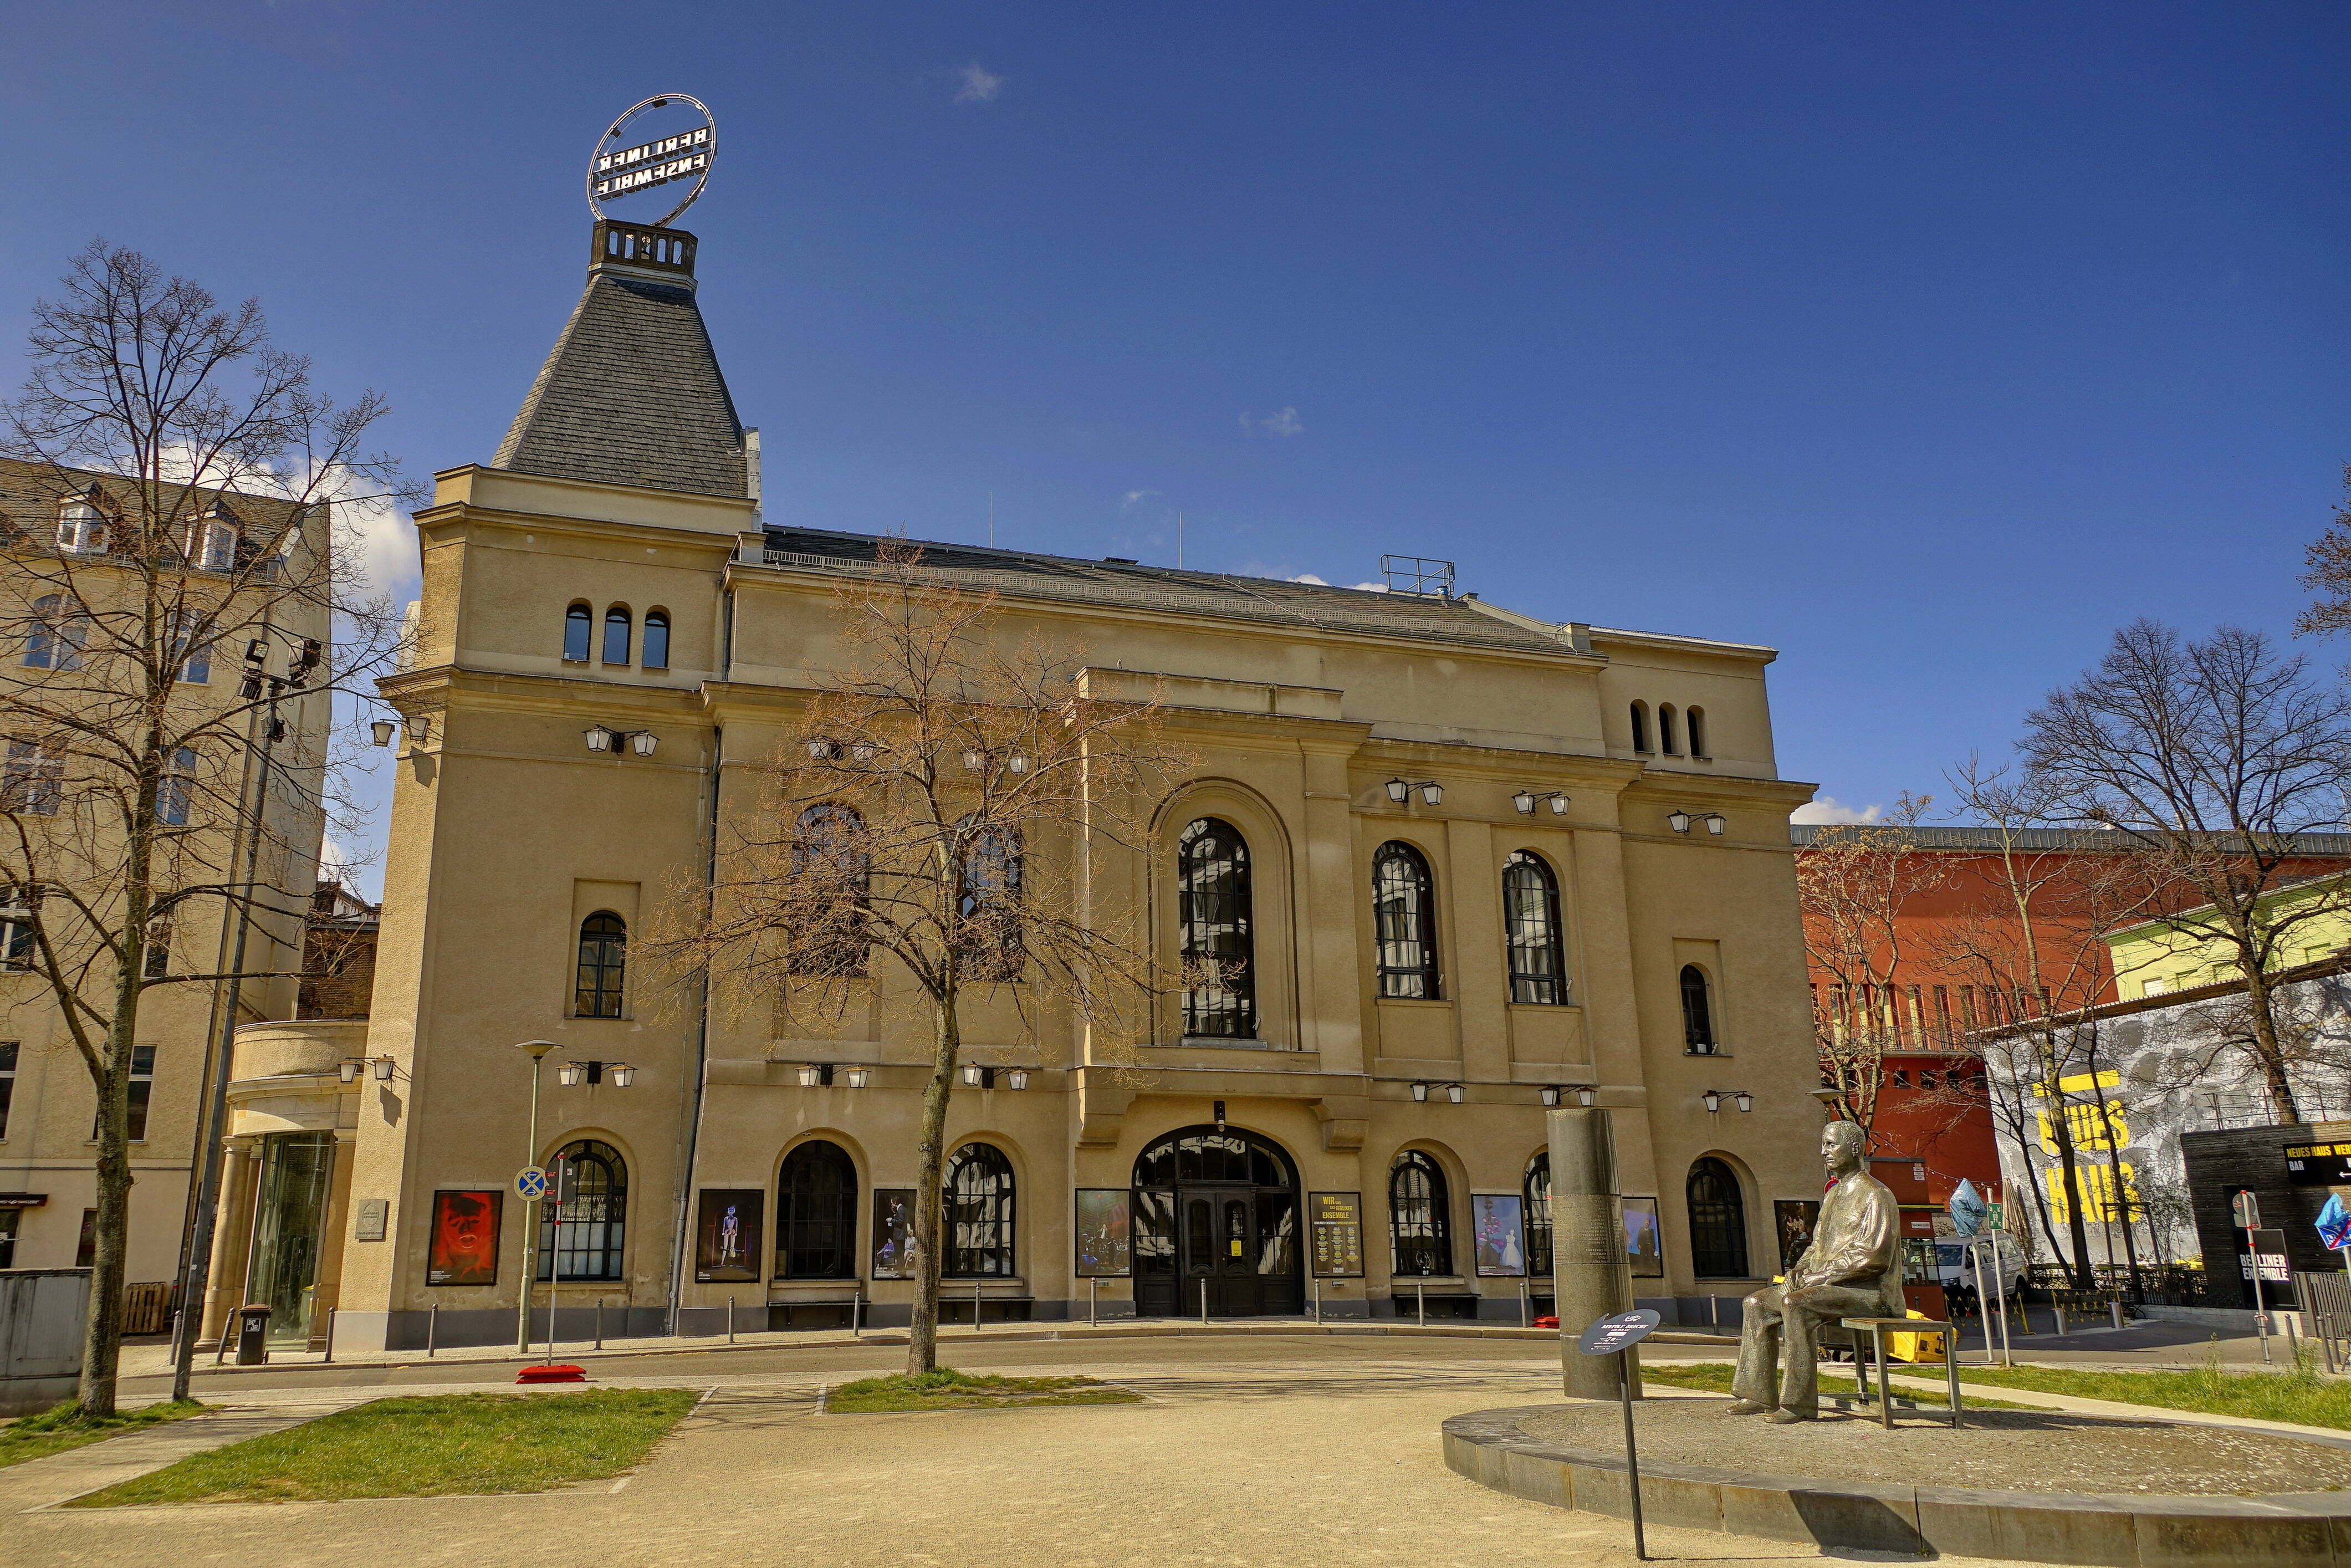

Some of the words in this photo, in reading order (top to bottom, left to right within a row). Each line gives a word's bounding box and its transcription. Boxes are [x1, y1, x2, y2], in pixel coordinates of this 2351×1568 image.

[2036, 1100, 2129, 1154] NUES
[2286, 1146, 2311, 1158] NEUES
[2311, 1145, 2332, 1156] HAUS
[2333, 1144, 2351, 1155] WER
[2288, 1160, 2304, 1171] BAR
[1322, 1196, 1335, 1205] WIR
[2240, 1254, 2287, 1268] BELINER
[2242, 1267, 2289, 1281] ENEMBLE
